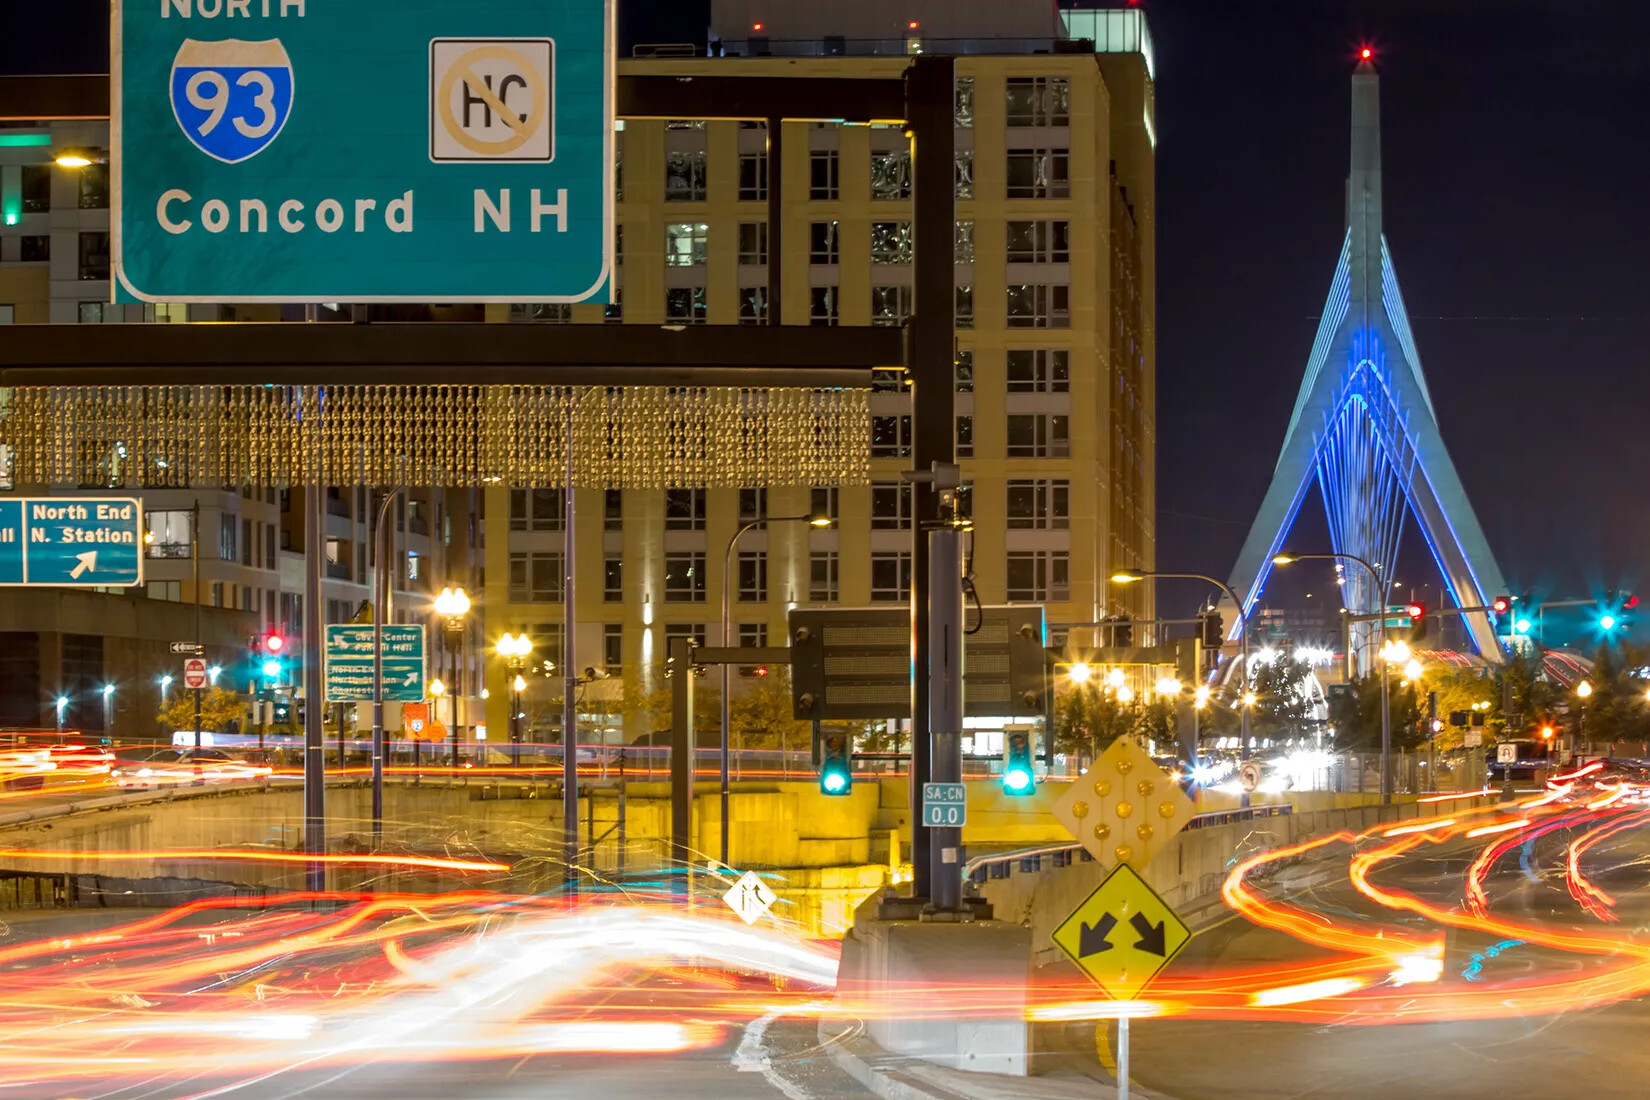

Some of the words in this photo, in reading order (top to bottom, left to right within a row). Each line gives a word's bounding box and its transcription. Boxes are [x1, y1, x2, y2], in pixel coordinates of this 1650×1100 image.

[185, 69, 278, 139] 93
[461, 74, 529, 128] HC
[156, 188, 414, 235] Concord
[473, 188, 568, 233] NH
[33, 504, 88, 520] North
[96, 504, 131, 520] End
[31, 527, 51, 543] N.
[61, 527, 133, 543] Station
[932, 807, 958, 824] 0.0
